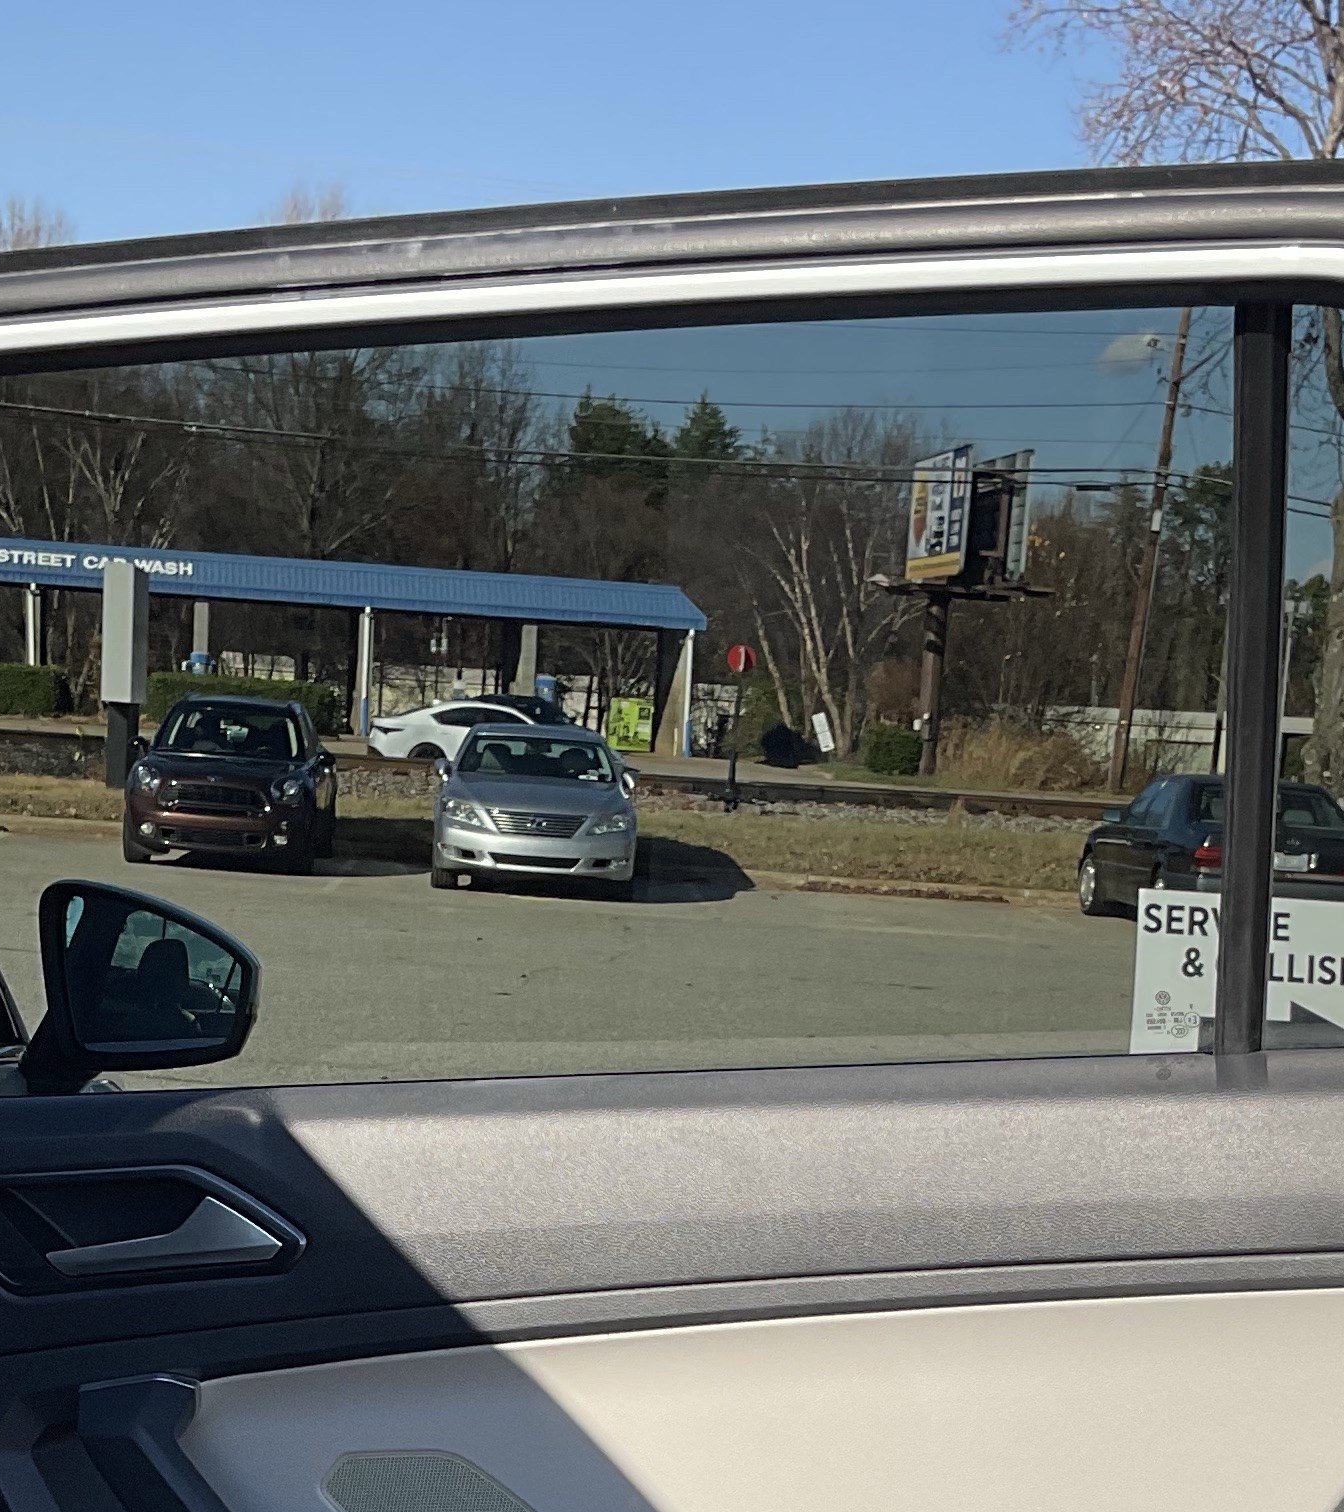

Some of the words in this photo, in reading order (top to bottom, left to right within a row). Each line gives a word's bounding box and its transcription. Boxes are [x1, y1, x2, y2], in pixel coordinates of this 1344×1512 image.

[83, 554, 128, 569] CA
[133, 558, 193, 576] WASH
[1143, 903, 1290, 941] SERE
[1182, 947, 1204, 977] &
